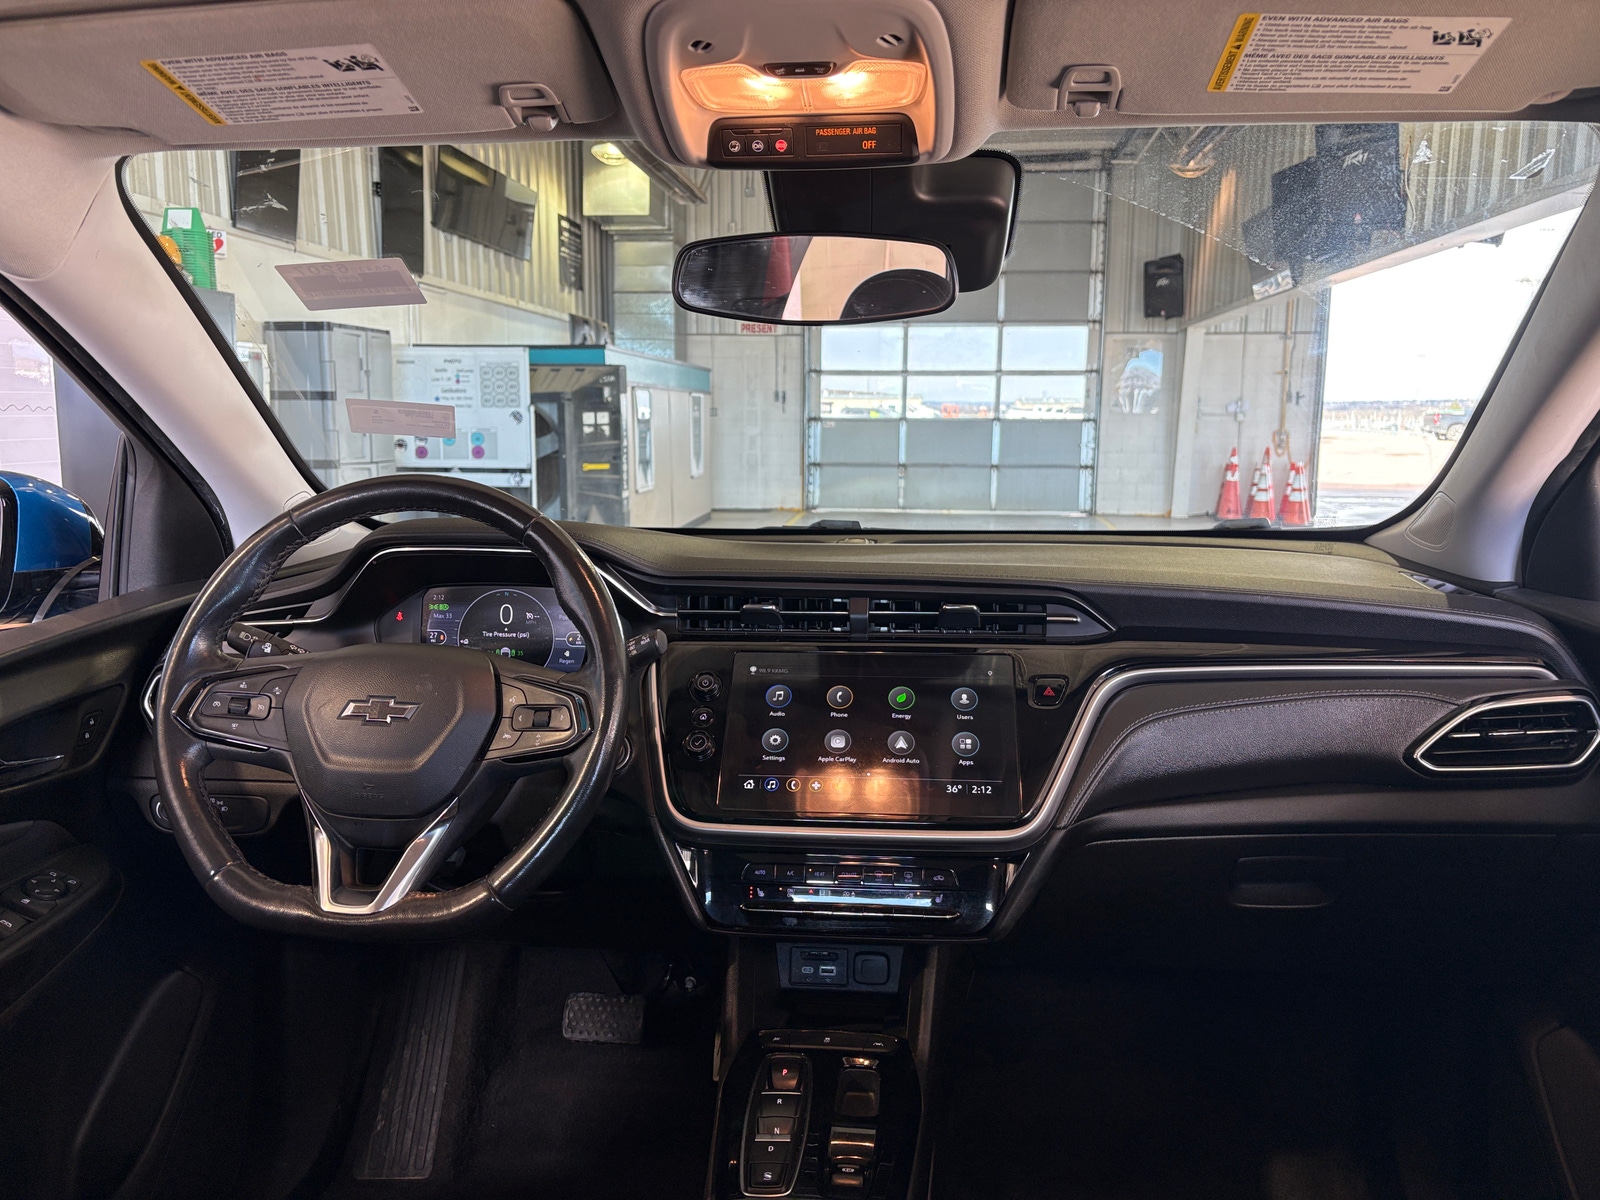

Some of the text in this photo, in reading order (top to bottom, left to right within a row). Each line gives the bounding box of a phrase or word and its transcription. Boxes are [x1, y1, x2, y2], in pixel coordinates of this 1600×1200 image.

[1234, 17, 1254, 43] WARNING
[1213, 51, 1238, 90] AVERTISSEMENT
[275, 83, 321, 91] GONFLABLES
[322, 80, 371, 88] INTELLIGENTS
[815, 128, 850, 136] PASSENGER
[852, 127, 863, 135] AIR
[862, 141, 877, 150] OFF
[741, 323, 778, 334] PRESENT
[500, 603, 513, 624] 0
[517, 631, 530, 640] (psi)
[835, 756, 857, 764] CarPlay
[946, 784, 962, 793] 36°
[972, 785, 992, 794] 2:12
[781, 1068, 789, 1076] P
